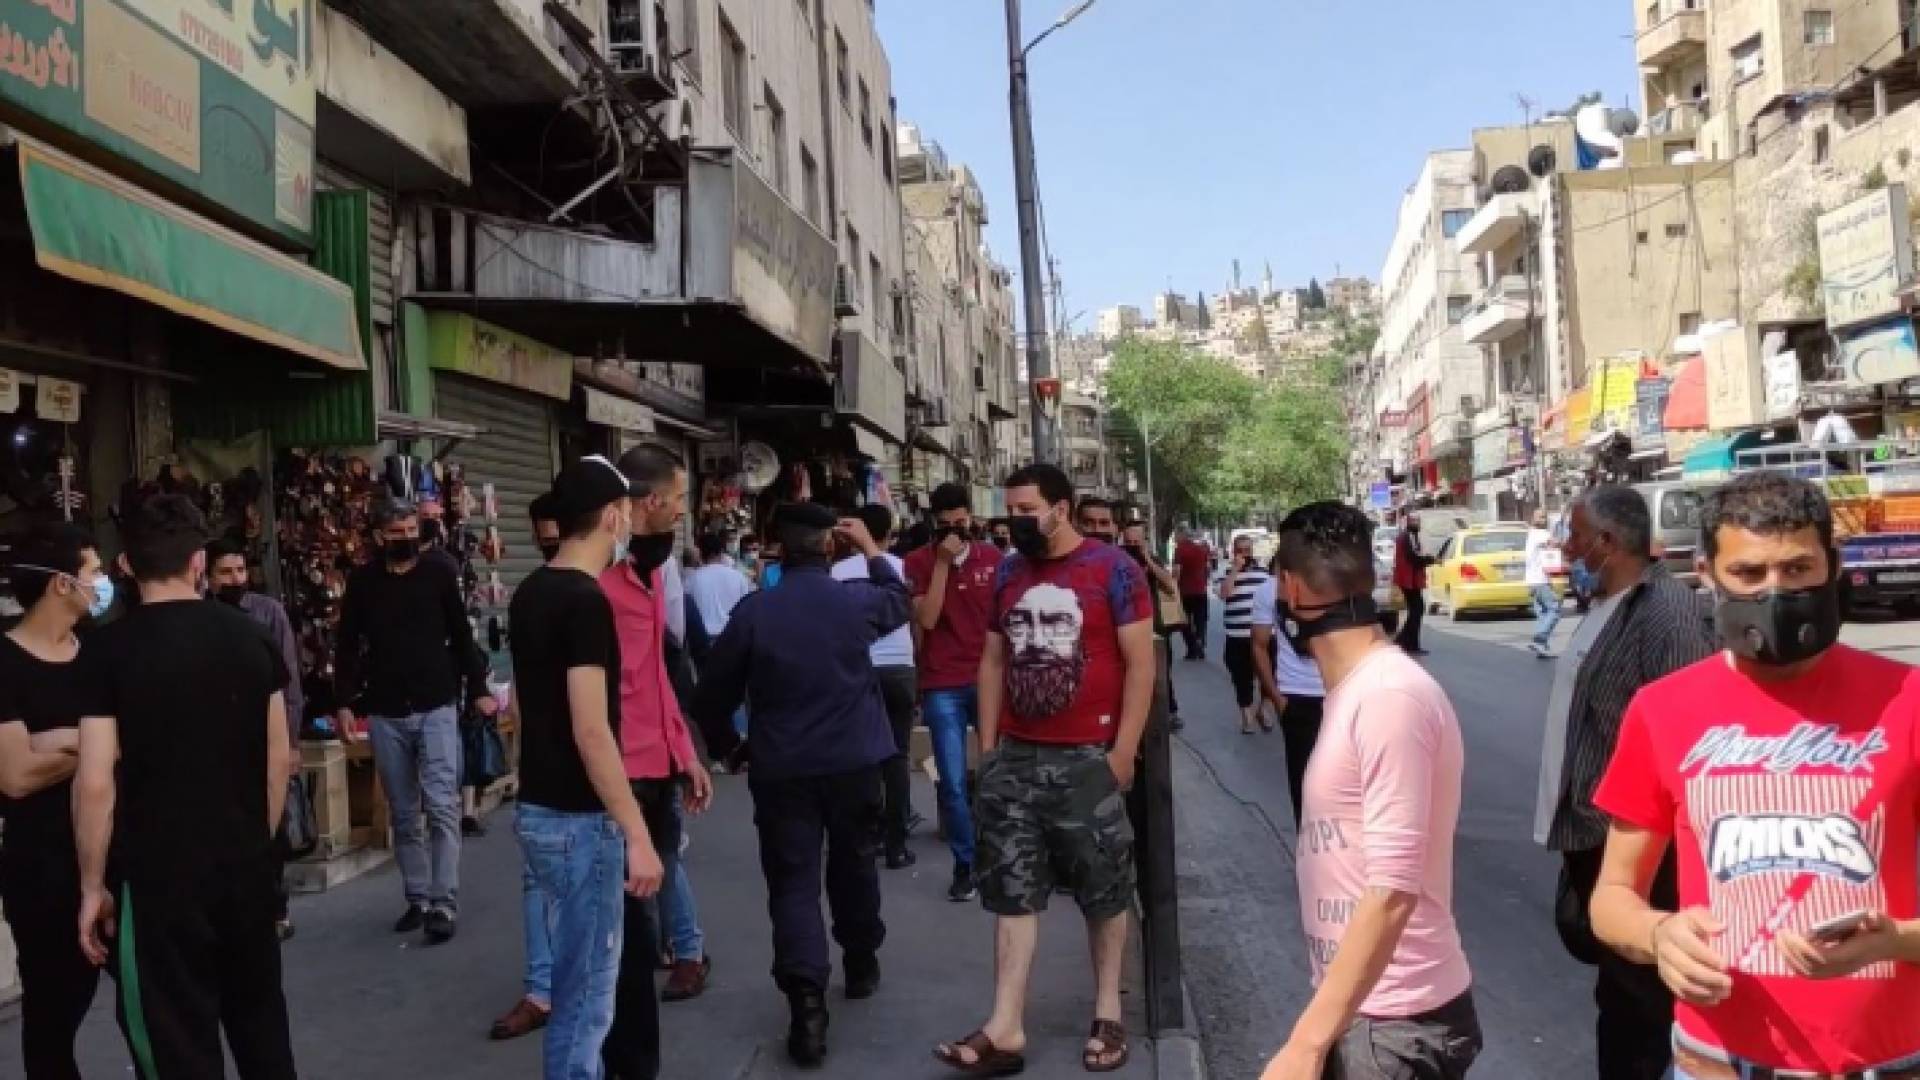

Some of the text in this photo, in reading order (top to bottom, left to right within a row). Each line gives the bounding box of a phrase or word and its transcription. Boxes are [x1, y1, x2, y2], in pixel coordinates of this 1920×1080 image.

[1678, 721, 1889, 774] New York
[1709, 813, 1876, 882] KNICKS
